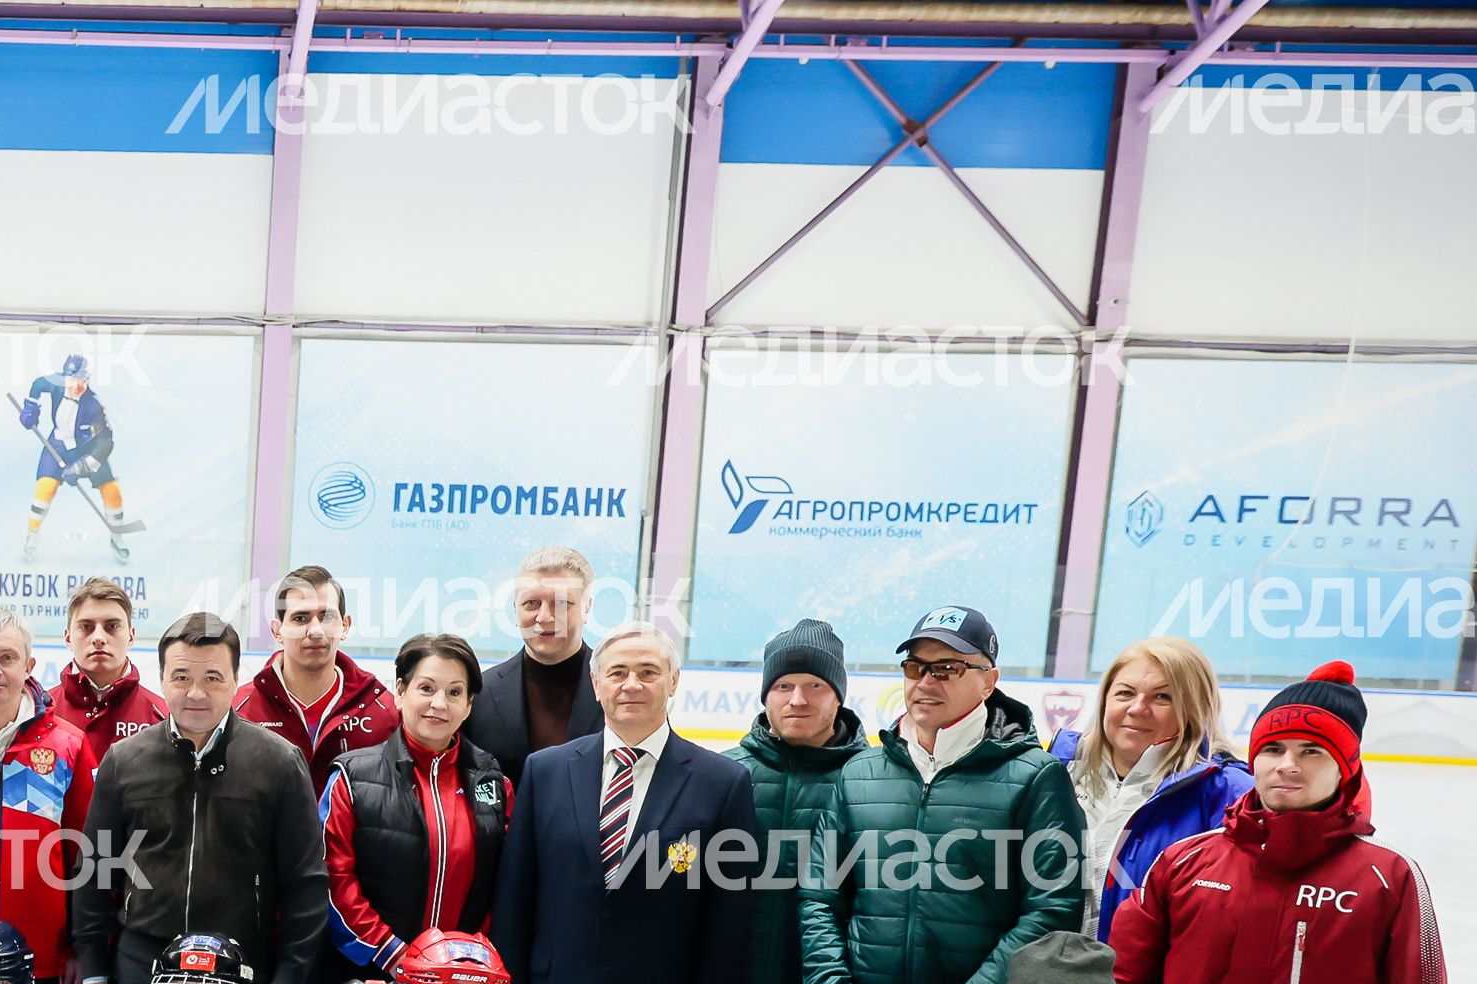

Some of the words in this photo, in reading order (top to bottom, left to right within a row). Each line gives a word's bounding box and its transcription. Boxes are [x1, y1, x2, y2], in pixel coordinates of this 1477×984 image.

[393, 483, 626, 517] ГАЗПРОМБАНК
[1188, 494, 1461, 527] AFORRA
[772, 500, 1038, 524] АГРОПРОМКРЕДИТ
[769, 525, 882, 539] коммерческий
[889, 525, 923, 538] банк
[1183, 534, 1461, 551] DEVELOPMENT
[0, 573, 59, 597] КУБОК
[1268, 708, 1323, 731] RPC
[1192, 879, 1231, 891] FORWARD
[1296, 884, 1359, 913] RPC
[451, 973, 487, 983] BAUER
